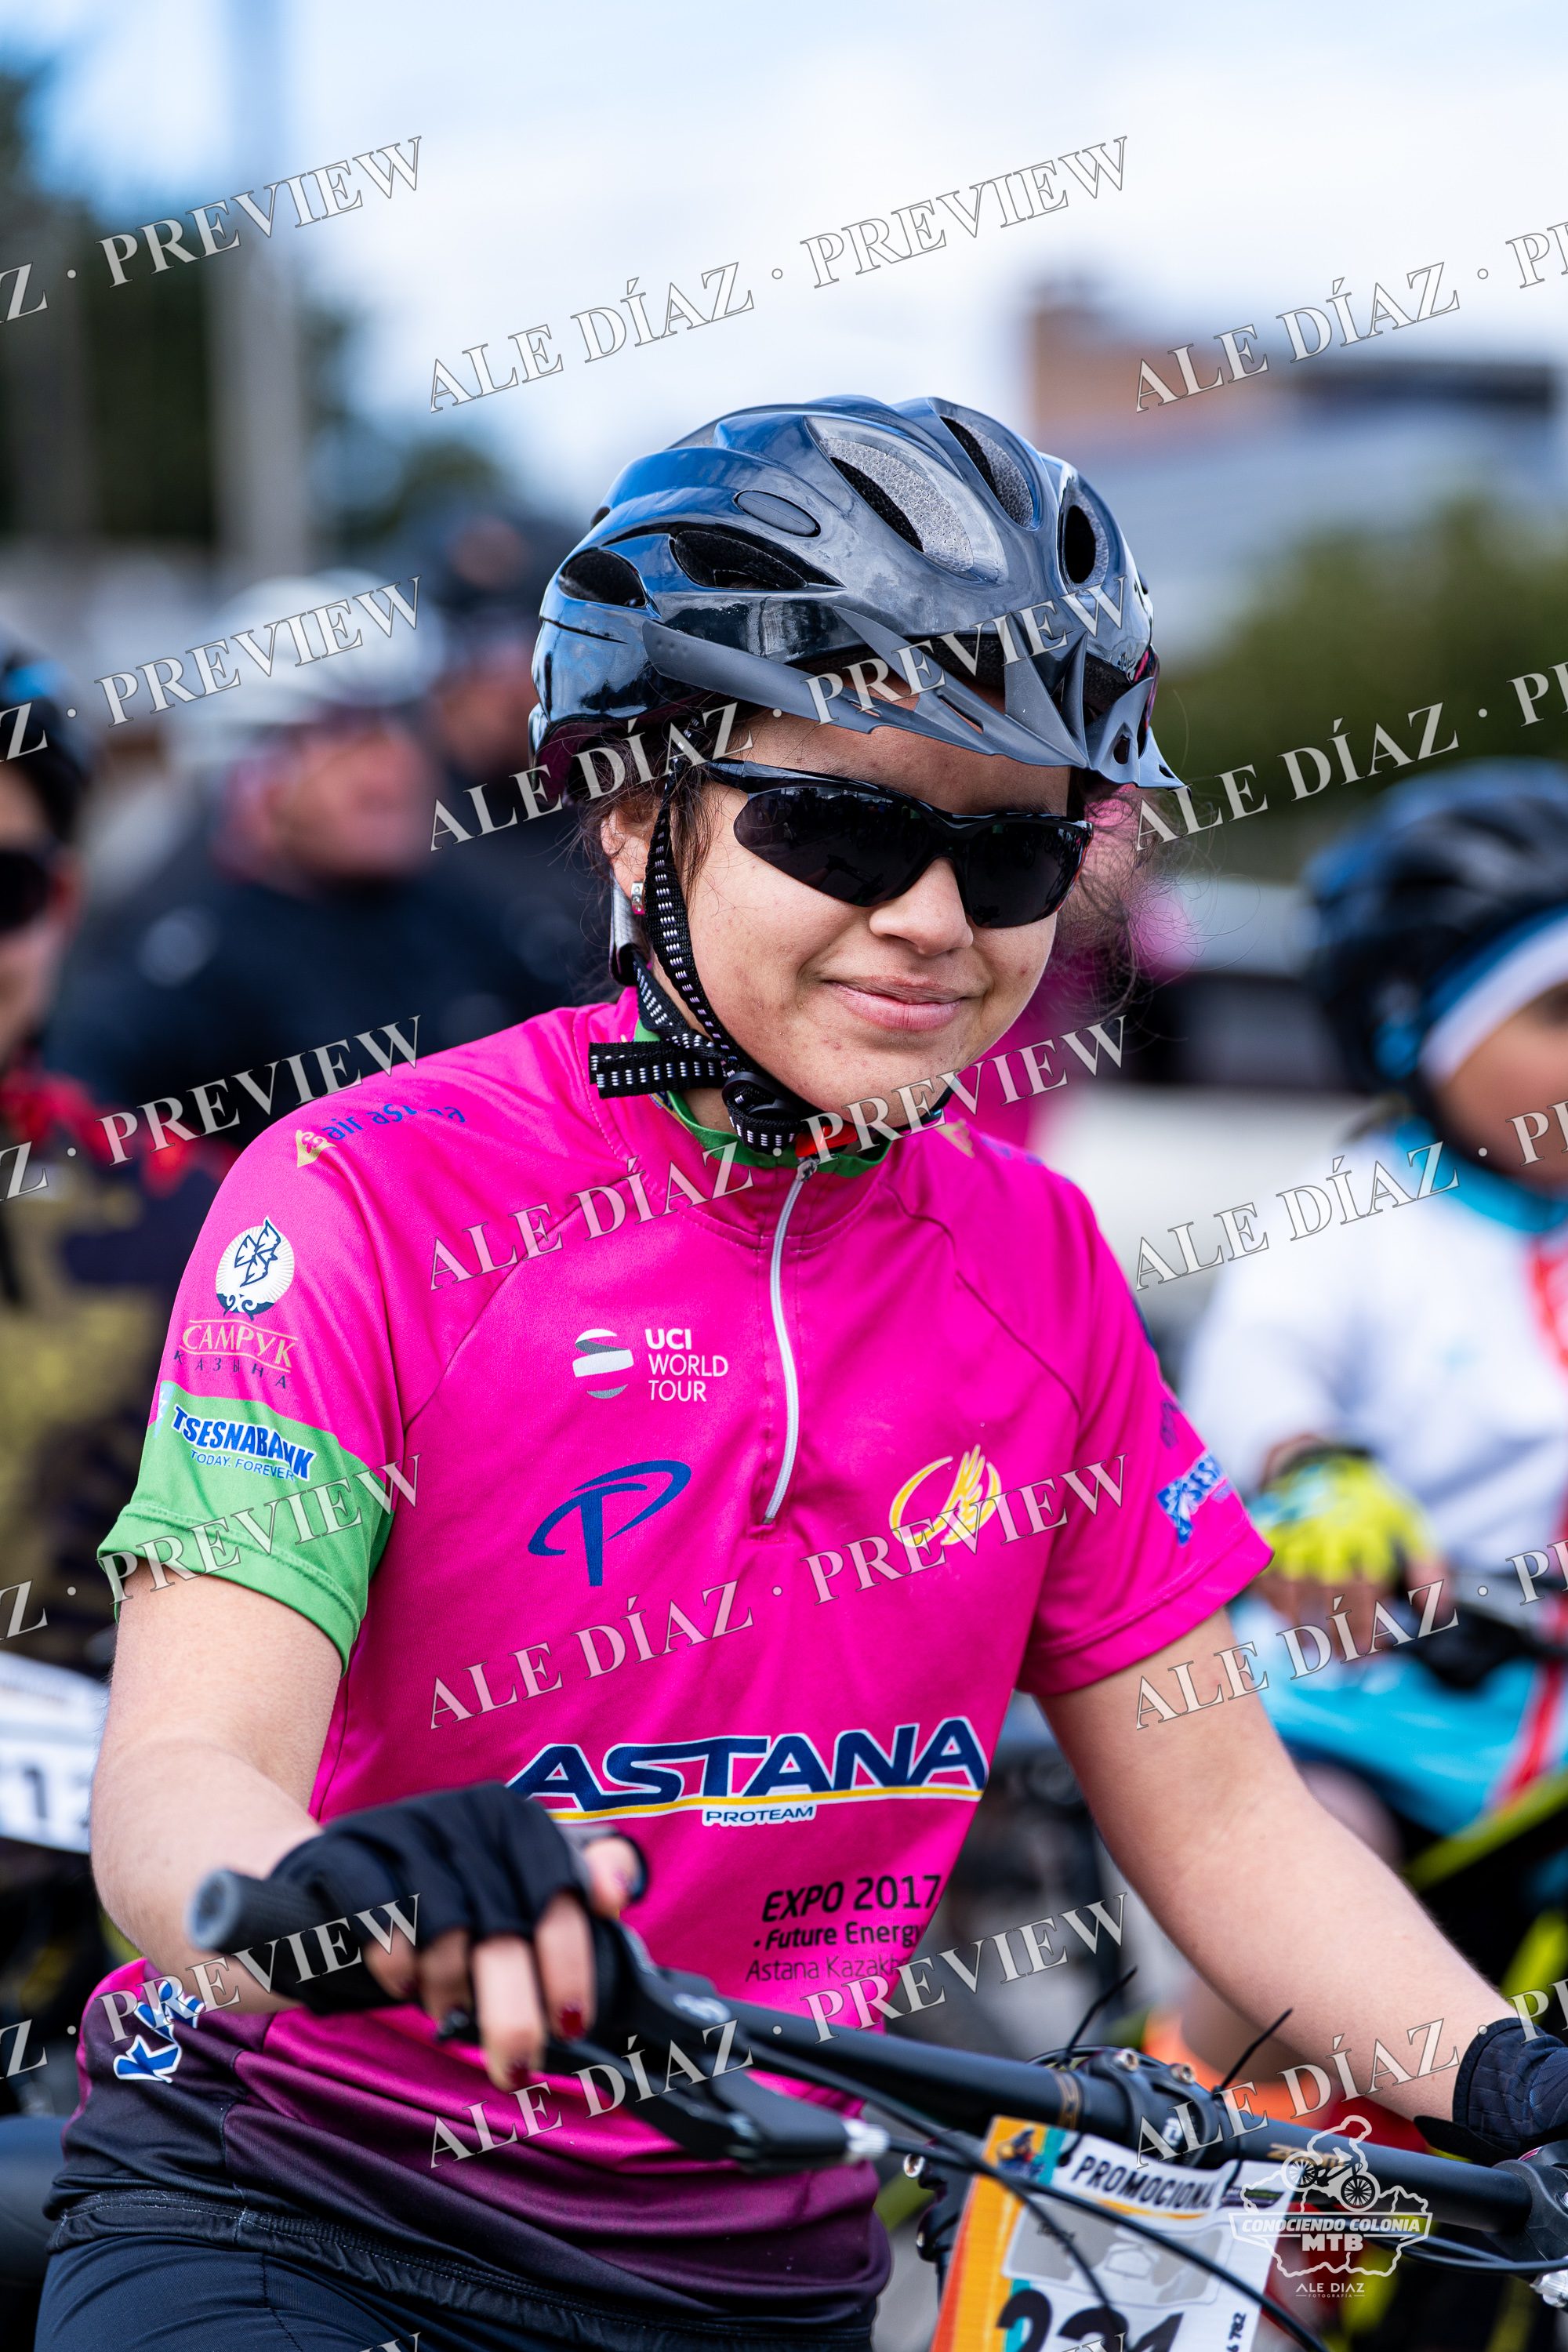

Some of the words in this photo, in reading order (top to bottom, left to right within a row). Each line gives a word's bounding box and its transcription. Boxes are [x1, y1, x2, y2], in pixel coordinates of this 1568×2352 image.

[645, 1328, 691, 1350] UCI
[648, 1353, 728, 1377] WORLD
[648, 1380, 706, 1402] TOUR
[506, 1715, 989, 1813] ASTANA
[706, 1806, 815, 1824] PROTEAM
[762, 1882, 844, 1922] EXPO
[854, 1875, 941, 1911] 2017
[765, 1926, 837, 1951] Future
[746, 1958, 819, 1983] Astana
